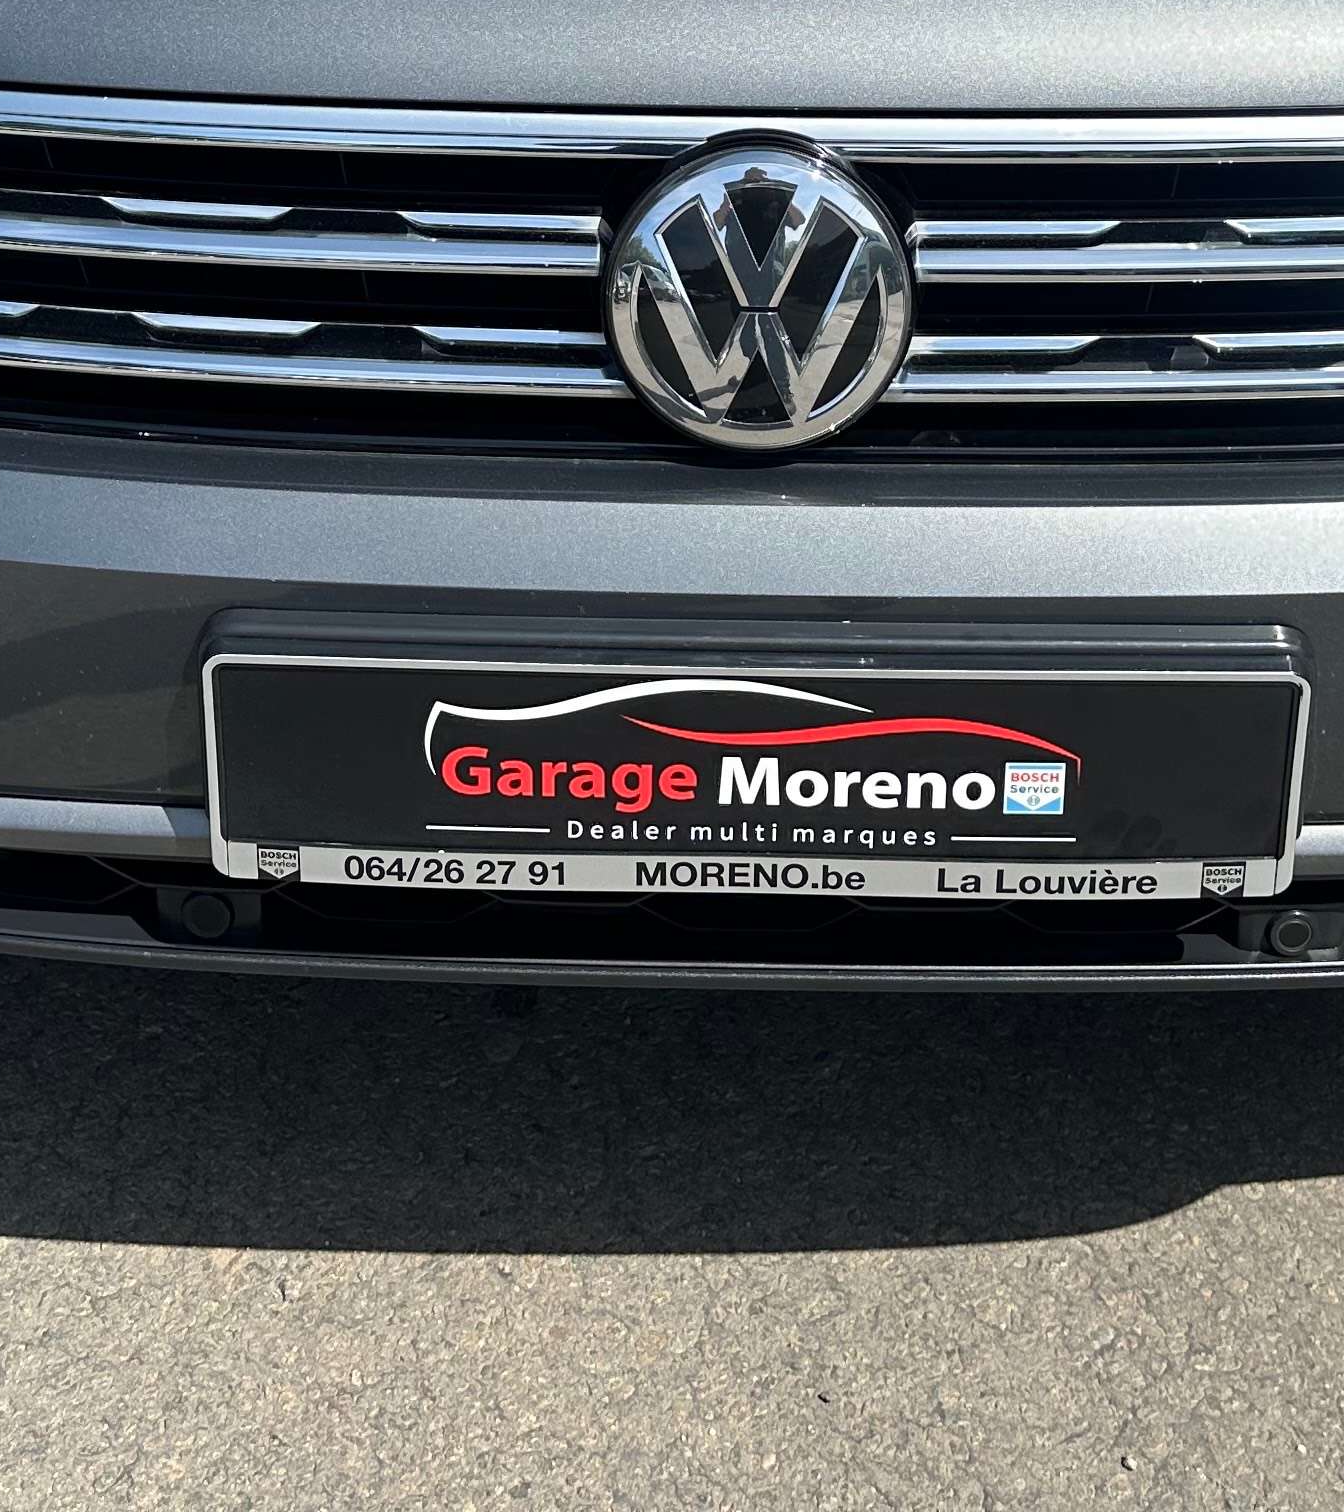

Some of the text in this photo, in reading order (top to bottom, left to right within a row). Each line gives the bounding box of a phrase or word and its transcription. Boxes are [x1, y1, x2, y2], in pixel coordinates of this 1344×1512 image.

[441, 746, 996, 813] Garage Moreno
[1010, 772, 1060, 783] BOSCH
[1010, 784, 1059, 794] Service
[567, 820, 936, 849] Dealer multi marques
[260, 850, 297, 861] BOSCH
[344, 855, 1158, 895] 064/26 27 91 MORENO.be La Louvière
[1205, 868, 1242, 877] BOSCH
